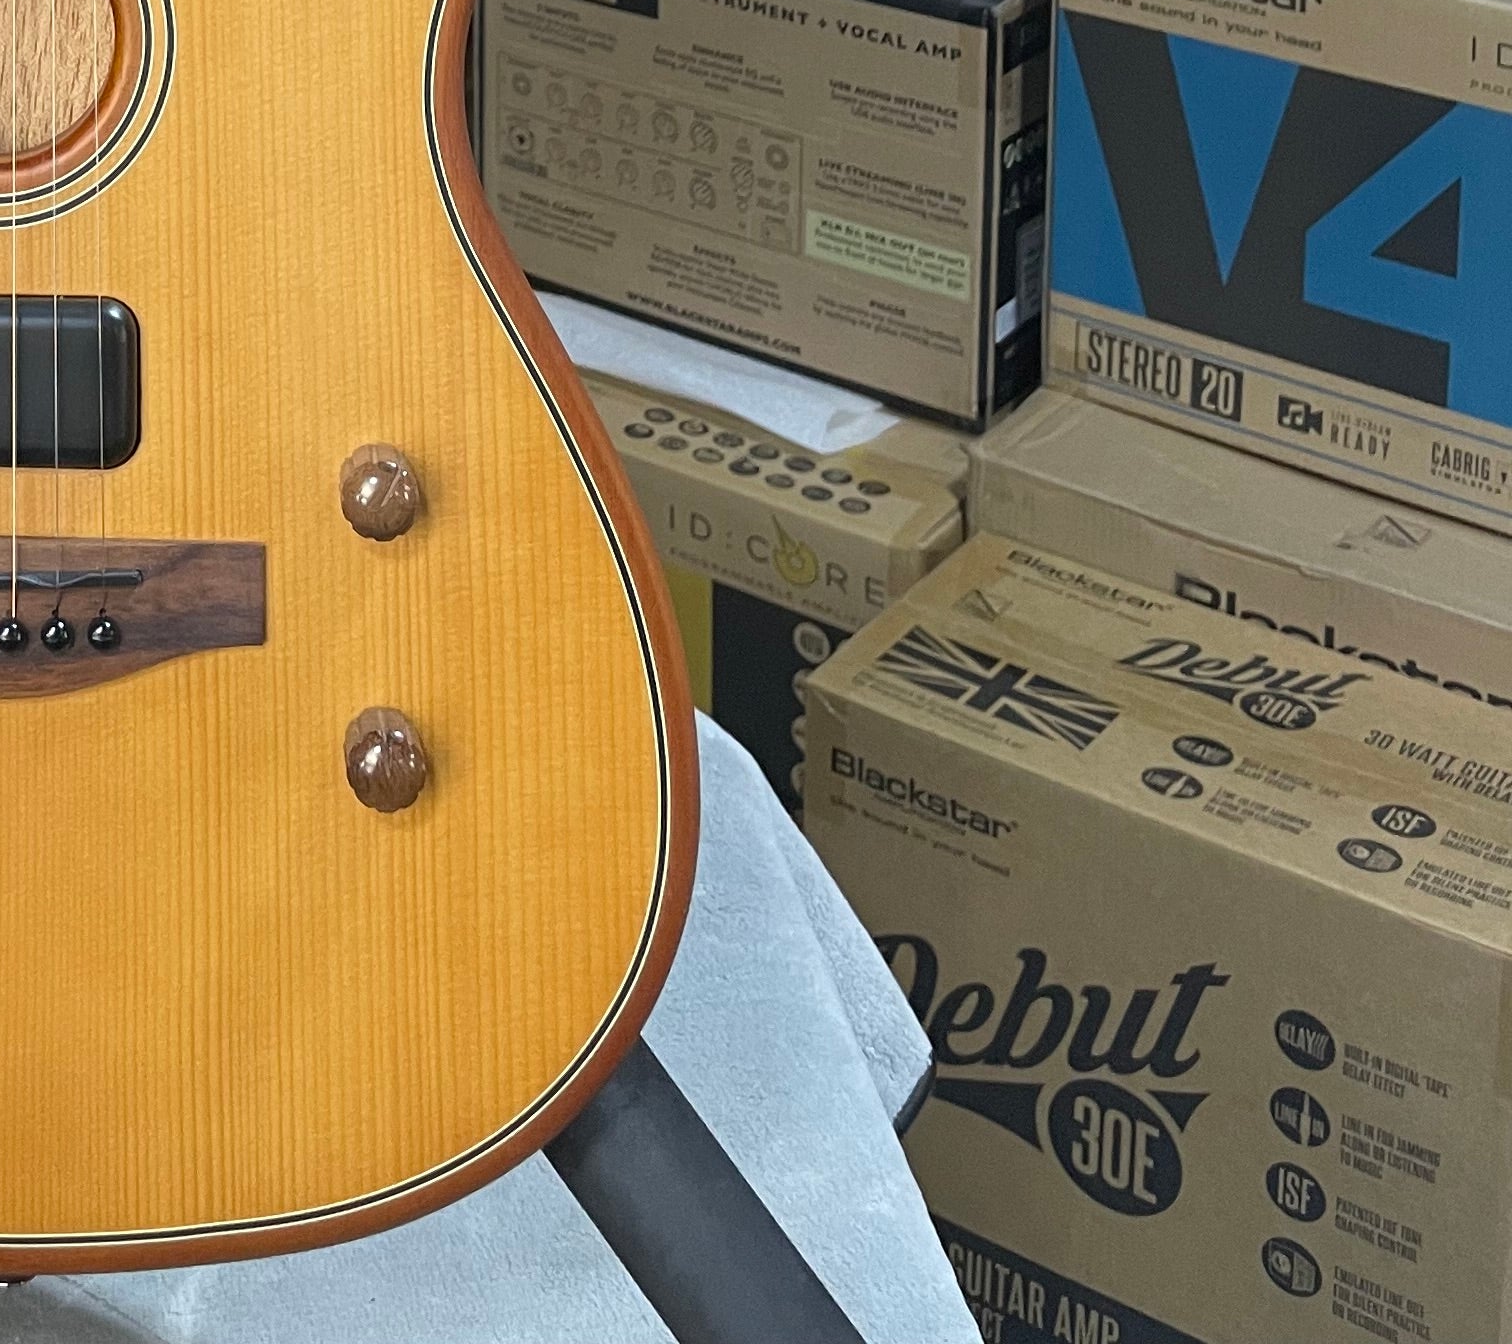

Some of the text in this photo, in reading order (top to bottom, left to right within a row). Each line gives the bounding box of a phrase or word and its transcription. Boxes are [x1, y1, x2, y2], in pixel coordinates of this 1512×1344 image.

[836, 17, 907, 51] VOCAL
[914, 38, 963, 62] AMP
[1201, 13, 1218, 27] in
[1224, 16, 1270, 43] your
[1275, 29, 1323, 53] head
[1088, 328, 1236, 417] STEREO 20
[1330, 423, 1391, 461] READY
[1431, 440, 1491, 482] CABRIG
[1007, 550, 1168, 611] Blackstar
[1116, 638, 1374, 700] Debut
[1249, 693, 1309, 728] 30E
[1364, 729, 1396, 751] 30
[1398, 738, 1461, 770] WATT
[831, 747, 1012, 838] Blackstar
[1431, 767, 1512, 805] WITH DELA
[1381, 806, 1427, 835] ISF
[874, 934, 1232, 1079] Debut
[1342, 1060, 1406, 1099] DELAY EFFECT
[1384, 1058, 1420, 1087] DIGITAL
[1071, 1095, 1161, 1206] 30E
[1340, 1132, 1370, 1157] ALONG
[1387, 1148, 1436, 1185] LISTENING
[1341, 1113, 1441, 1168] LINE IN FOR JAMMING
[1277, 1166, 1316, 1215] ISF
[1352, 1154, 1383, 1180] MUSIC
[1334, 1213, 1418, 1264] SHAPING CONTROL
[1335, 1196, 1381, 1229] PATENTED
[1400, 1225, 1424, 1249] TONE
[948, 1241, 1046, 1330] GUITAR
[1053, 1295, 1121, 1344] AMP
[1332, 1282, 1432, 1342] FOR SILENT PRACTICE
[1334, 1265, 1425, 1319] EMULATED LINE OUT
[1331, 1300, 1399, 1344] OR RECORDING
